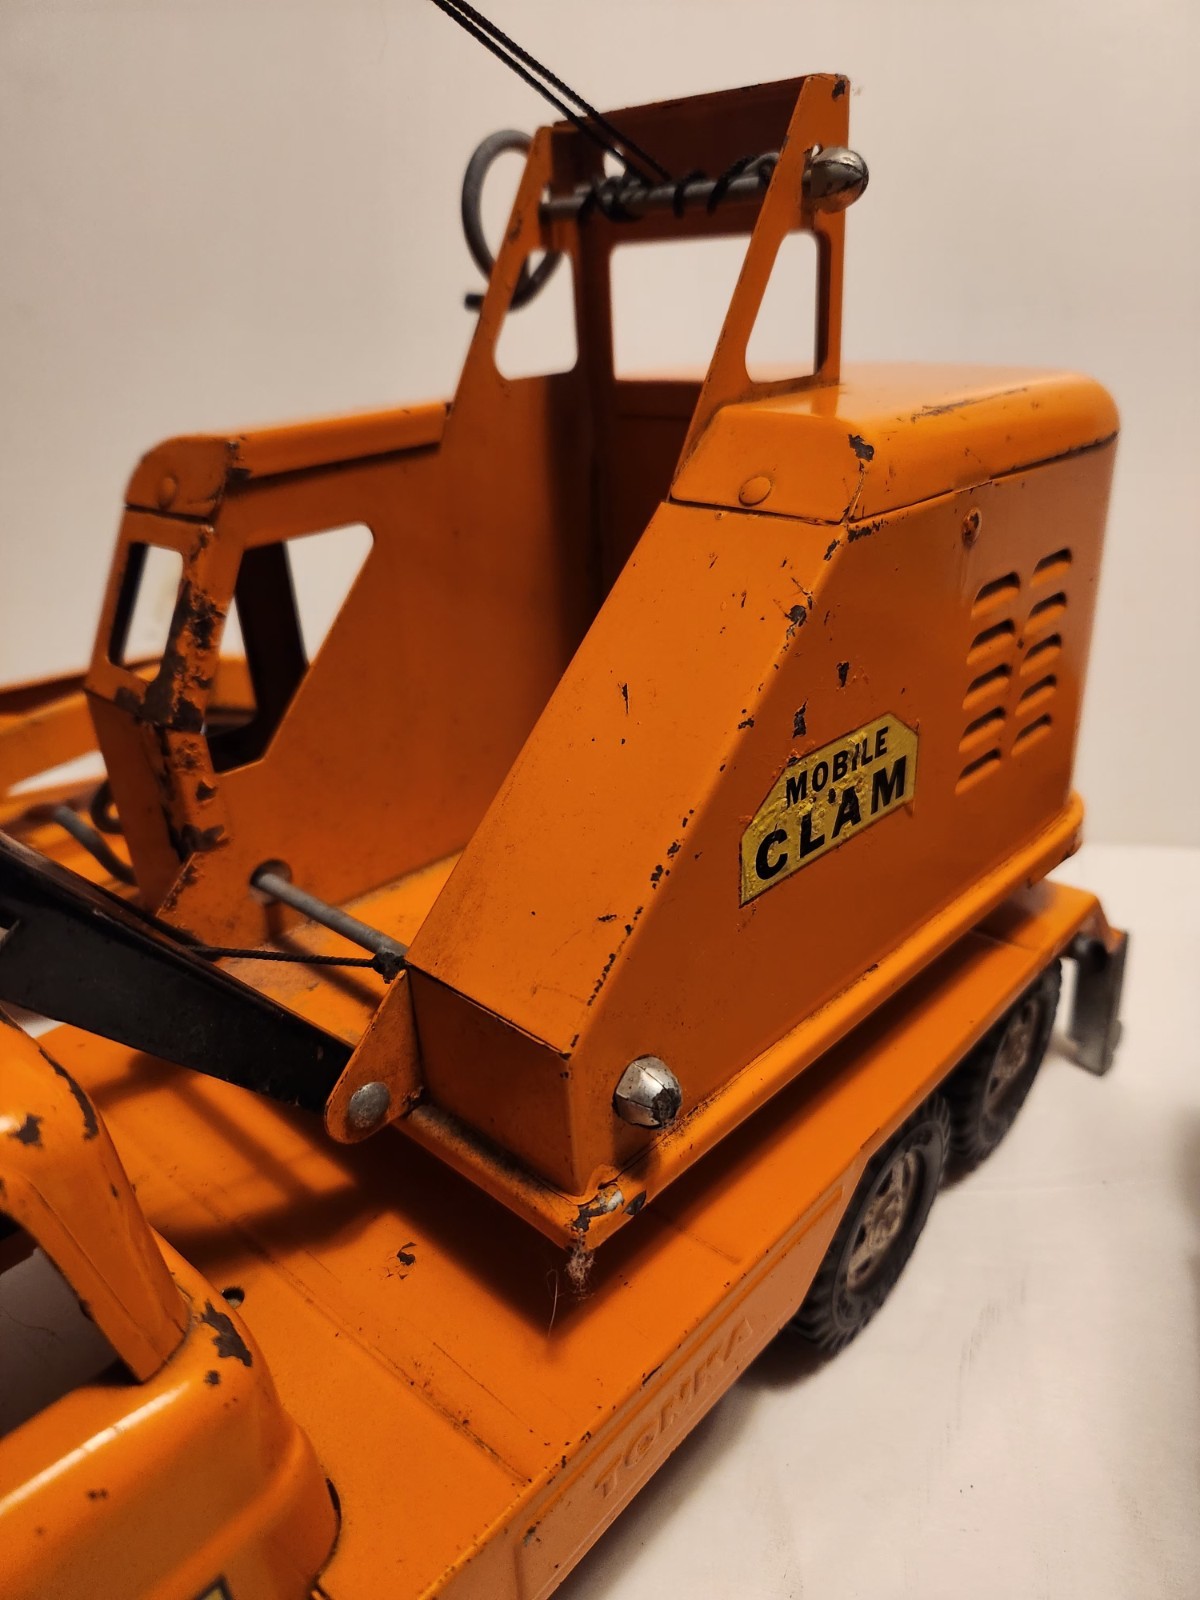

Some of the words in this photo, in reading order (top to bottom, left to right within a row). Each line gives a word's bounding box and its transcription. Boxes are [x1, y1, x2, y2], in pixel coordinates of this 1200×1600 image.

[755, 755, 907, 880] CLAM
[785, 726, 889, 809] MOBILE
[594, 1317, 753, 1498] TONKA
